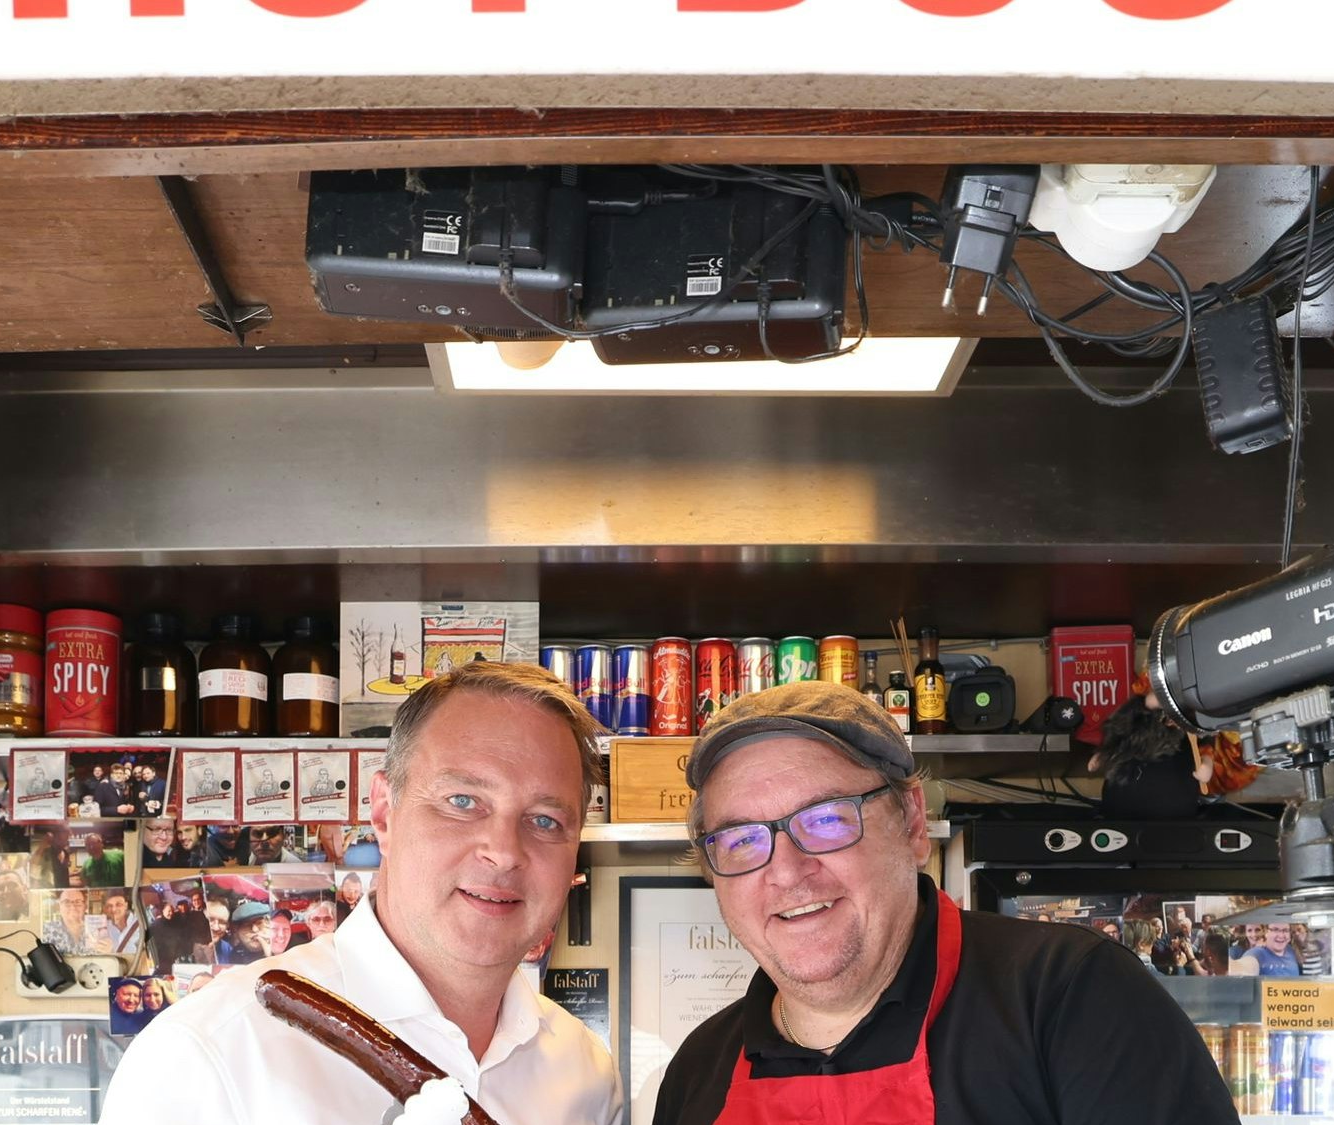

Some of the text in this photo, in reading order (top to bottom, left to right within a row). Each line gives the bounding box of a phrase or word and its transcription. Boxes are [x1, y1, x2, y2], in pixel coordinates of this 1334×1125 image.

[1286, 585, 1311, 601] LEGRIA
[1218, 627, 1272, 655] Canon
[59, 641, 105, 659] EXTRA
[1075, 661, 1114, 675] EXTRA
[53, 662, 110, 696] SPICY
[1073, 680, 1118, 706] SPICY
[659, 721, 688, 730] Original
[554, 973, 599, 988] falstaff
[1267, 987, 1319, 998] Es warad
[1267, 1004, 1315, 1014] wengan
[1267, 1017, 1313, 1027] leiwand
[16, 1107, 60, 1117] SCHARFEN
